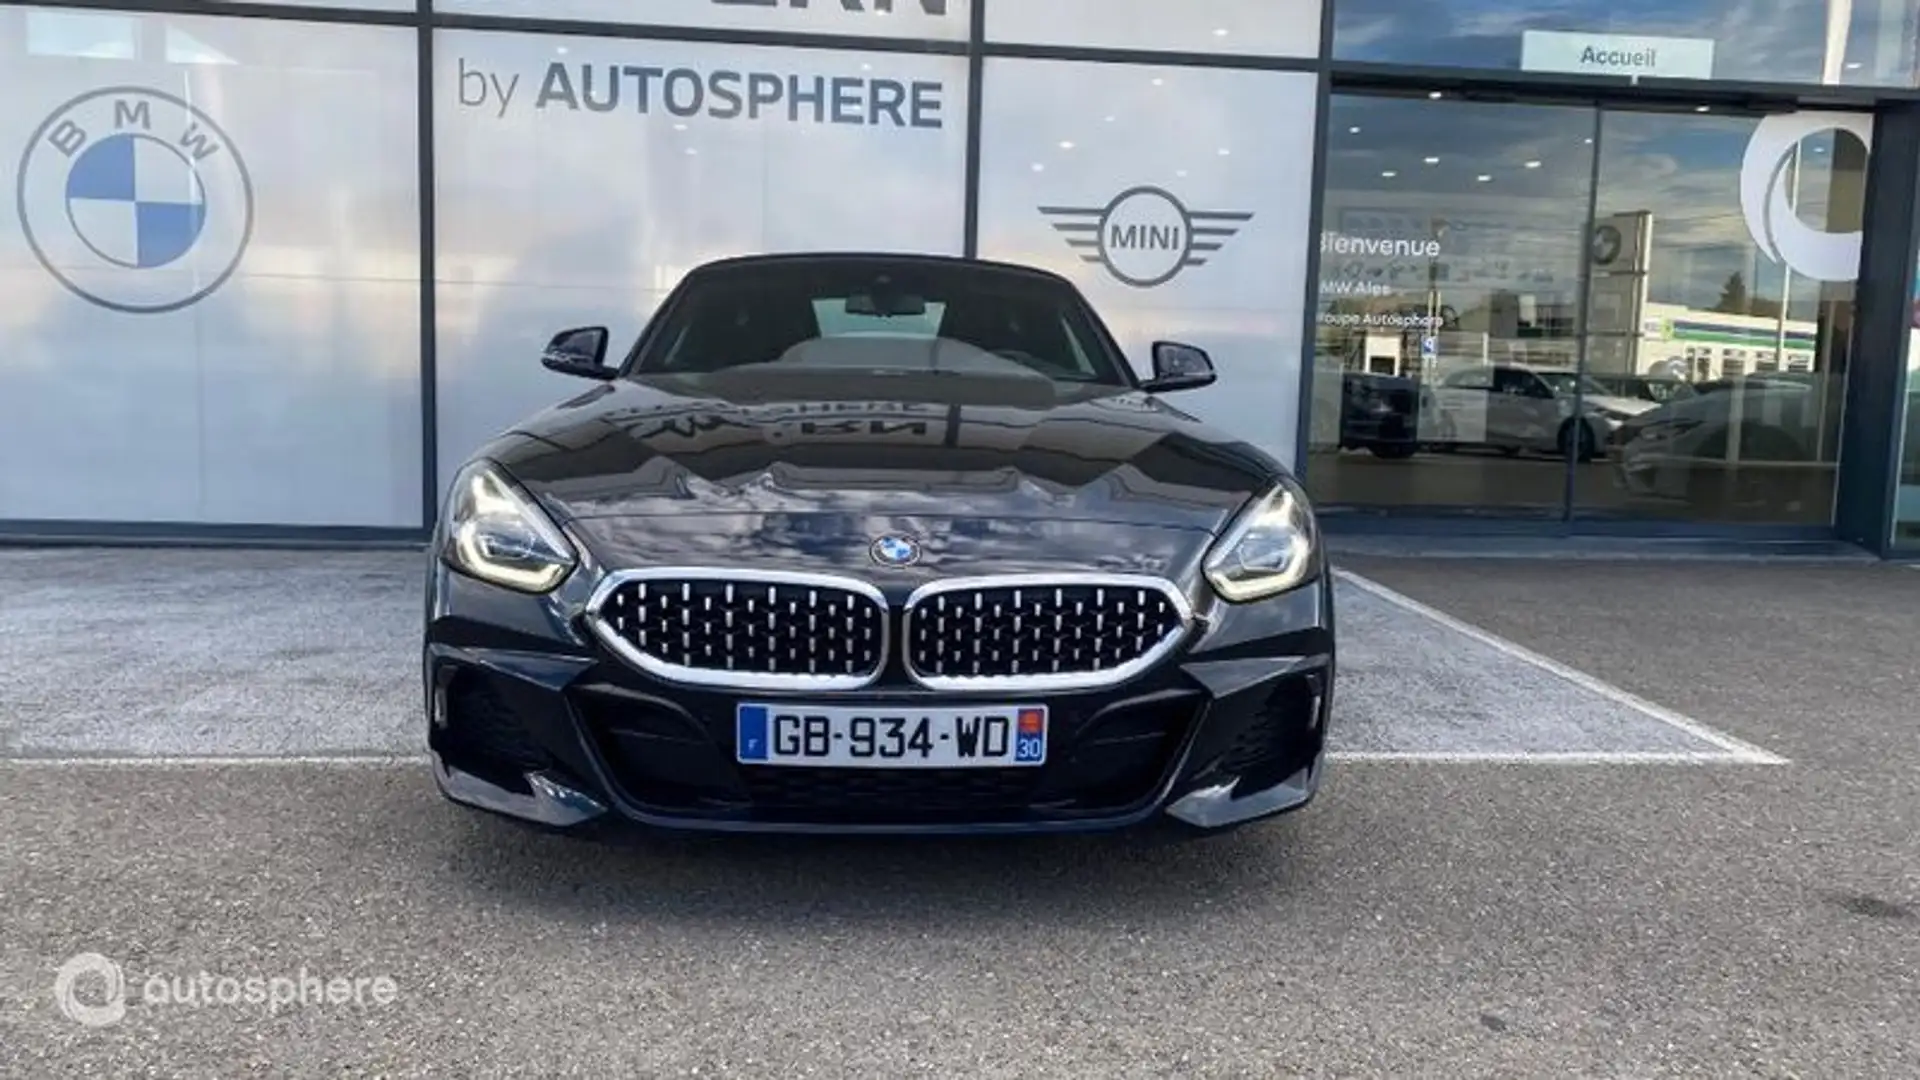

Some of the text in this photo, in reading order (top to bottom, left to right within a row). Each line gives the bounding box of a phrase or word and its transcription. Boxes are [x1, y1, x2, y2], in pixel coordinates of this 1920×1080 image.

[1580, 44, 1656, 68] Accueil
[458, 57, 943, 129] by AUTOSPHERE
[48, 100, 219, 160] BMW
[1110, 224, 1180, 251] MINI
[774, 714, 1010, 758] GB-934-WD
[1018, 738, 1041, 758] 30
